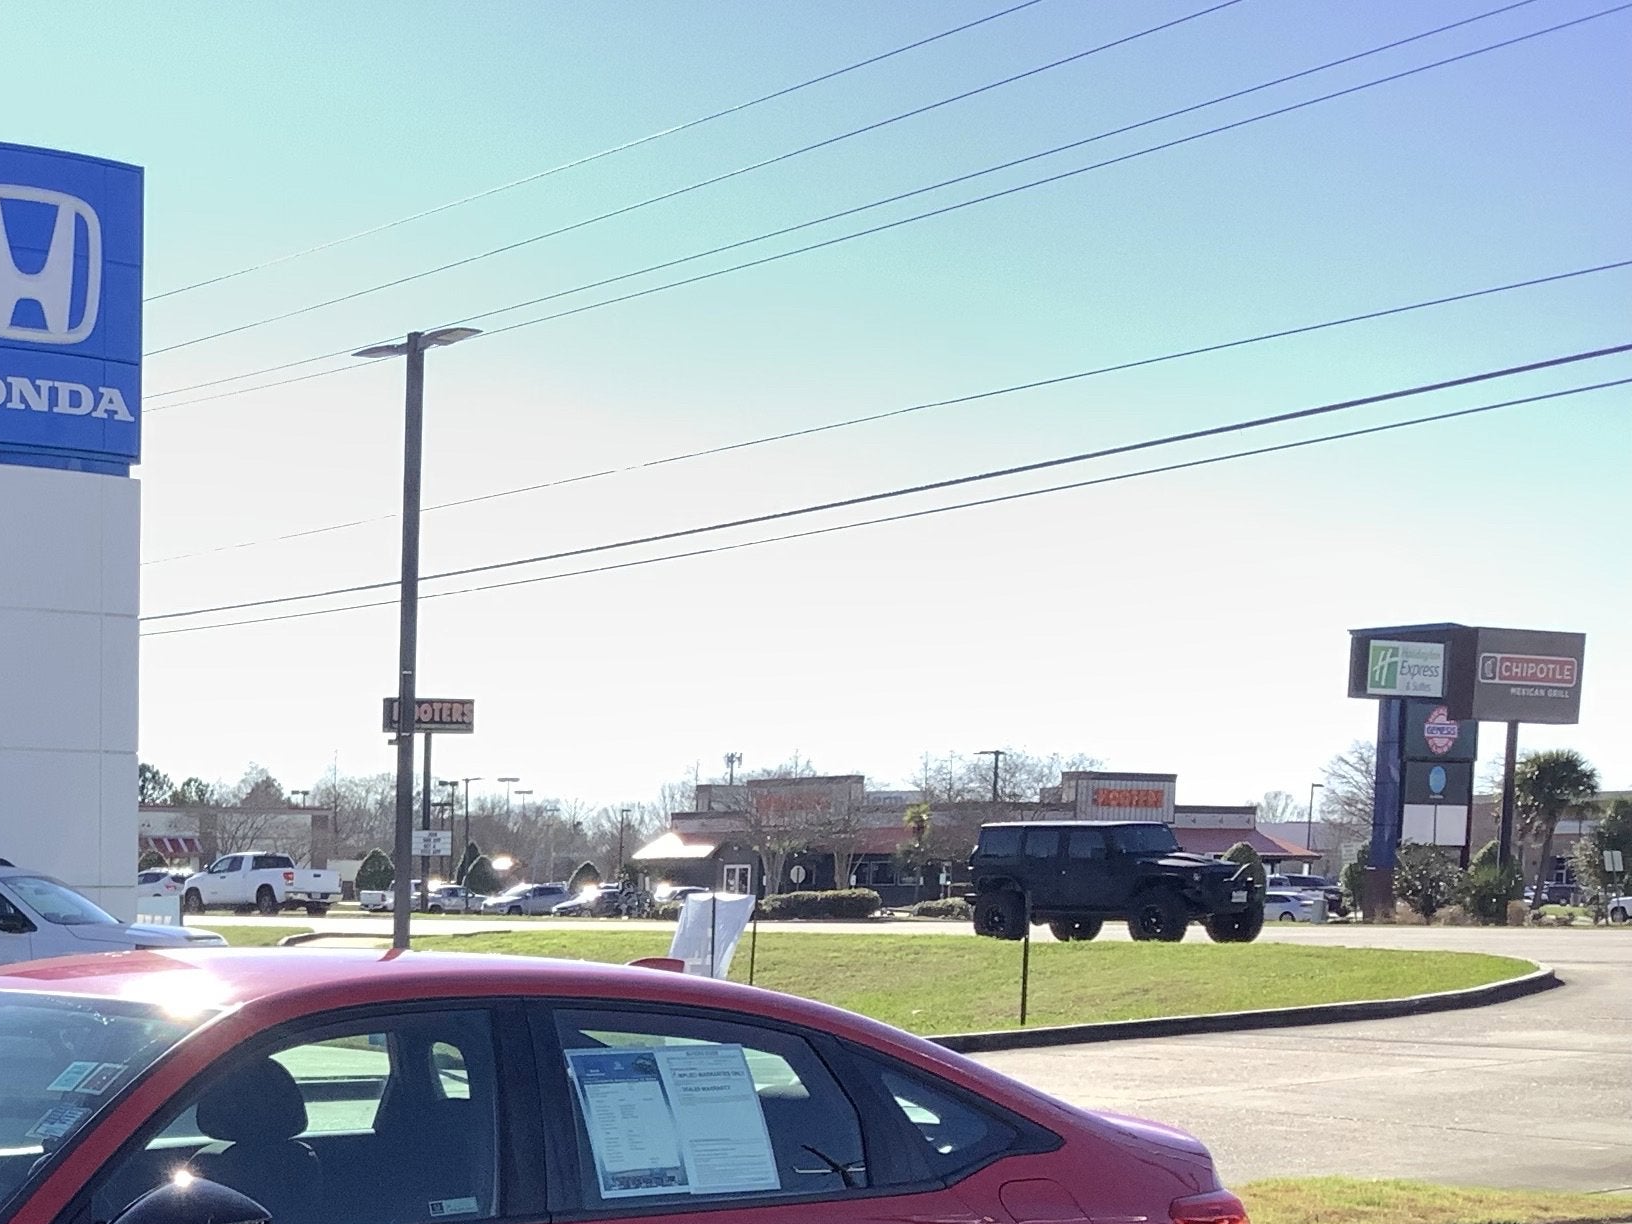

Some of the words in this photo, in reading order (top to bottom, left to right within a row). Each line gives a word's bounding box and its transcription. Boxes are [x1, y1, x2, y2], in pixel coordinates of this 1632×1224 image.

[1400, 660, 1440, 679] Express
[1501, 662, 1572, 679] CHIPOTLE
[1510, 687, 1545, 697] MEXICAN
[1547, 689, 1569, 698] GRILL
